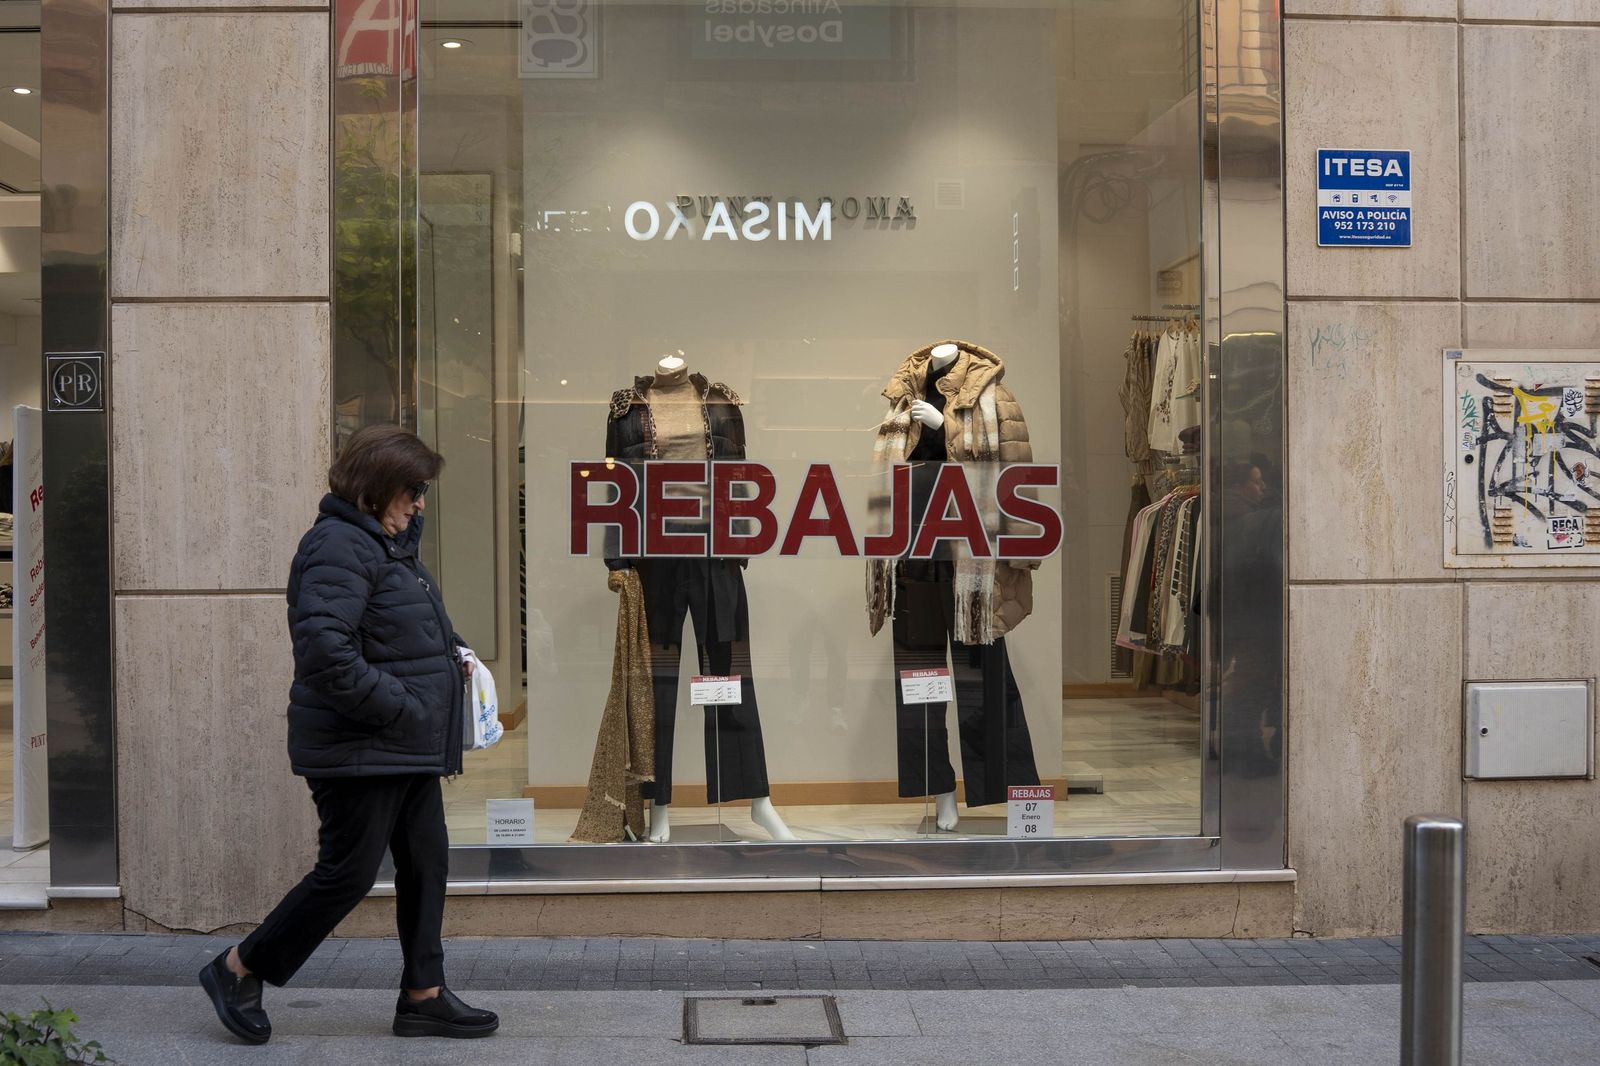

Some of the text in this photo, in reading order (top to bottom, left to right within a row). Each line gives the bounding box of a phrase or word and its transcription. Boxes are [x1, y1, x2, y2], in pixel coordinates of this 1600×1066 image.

[1324, 158, 1404, 177] ITESA
[1322, 209, 1407, 221] AVISO A POLICÍA
[1334, 221, 1396, 231] 952 173 210
[567, 459, 1064, 560] REBAJAS
[1012, 789, 1051, 798] REBAJAS
[1025, 802, 1037, 812] 07
[1024, 824, 1037, 833] 08
